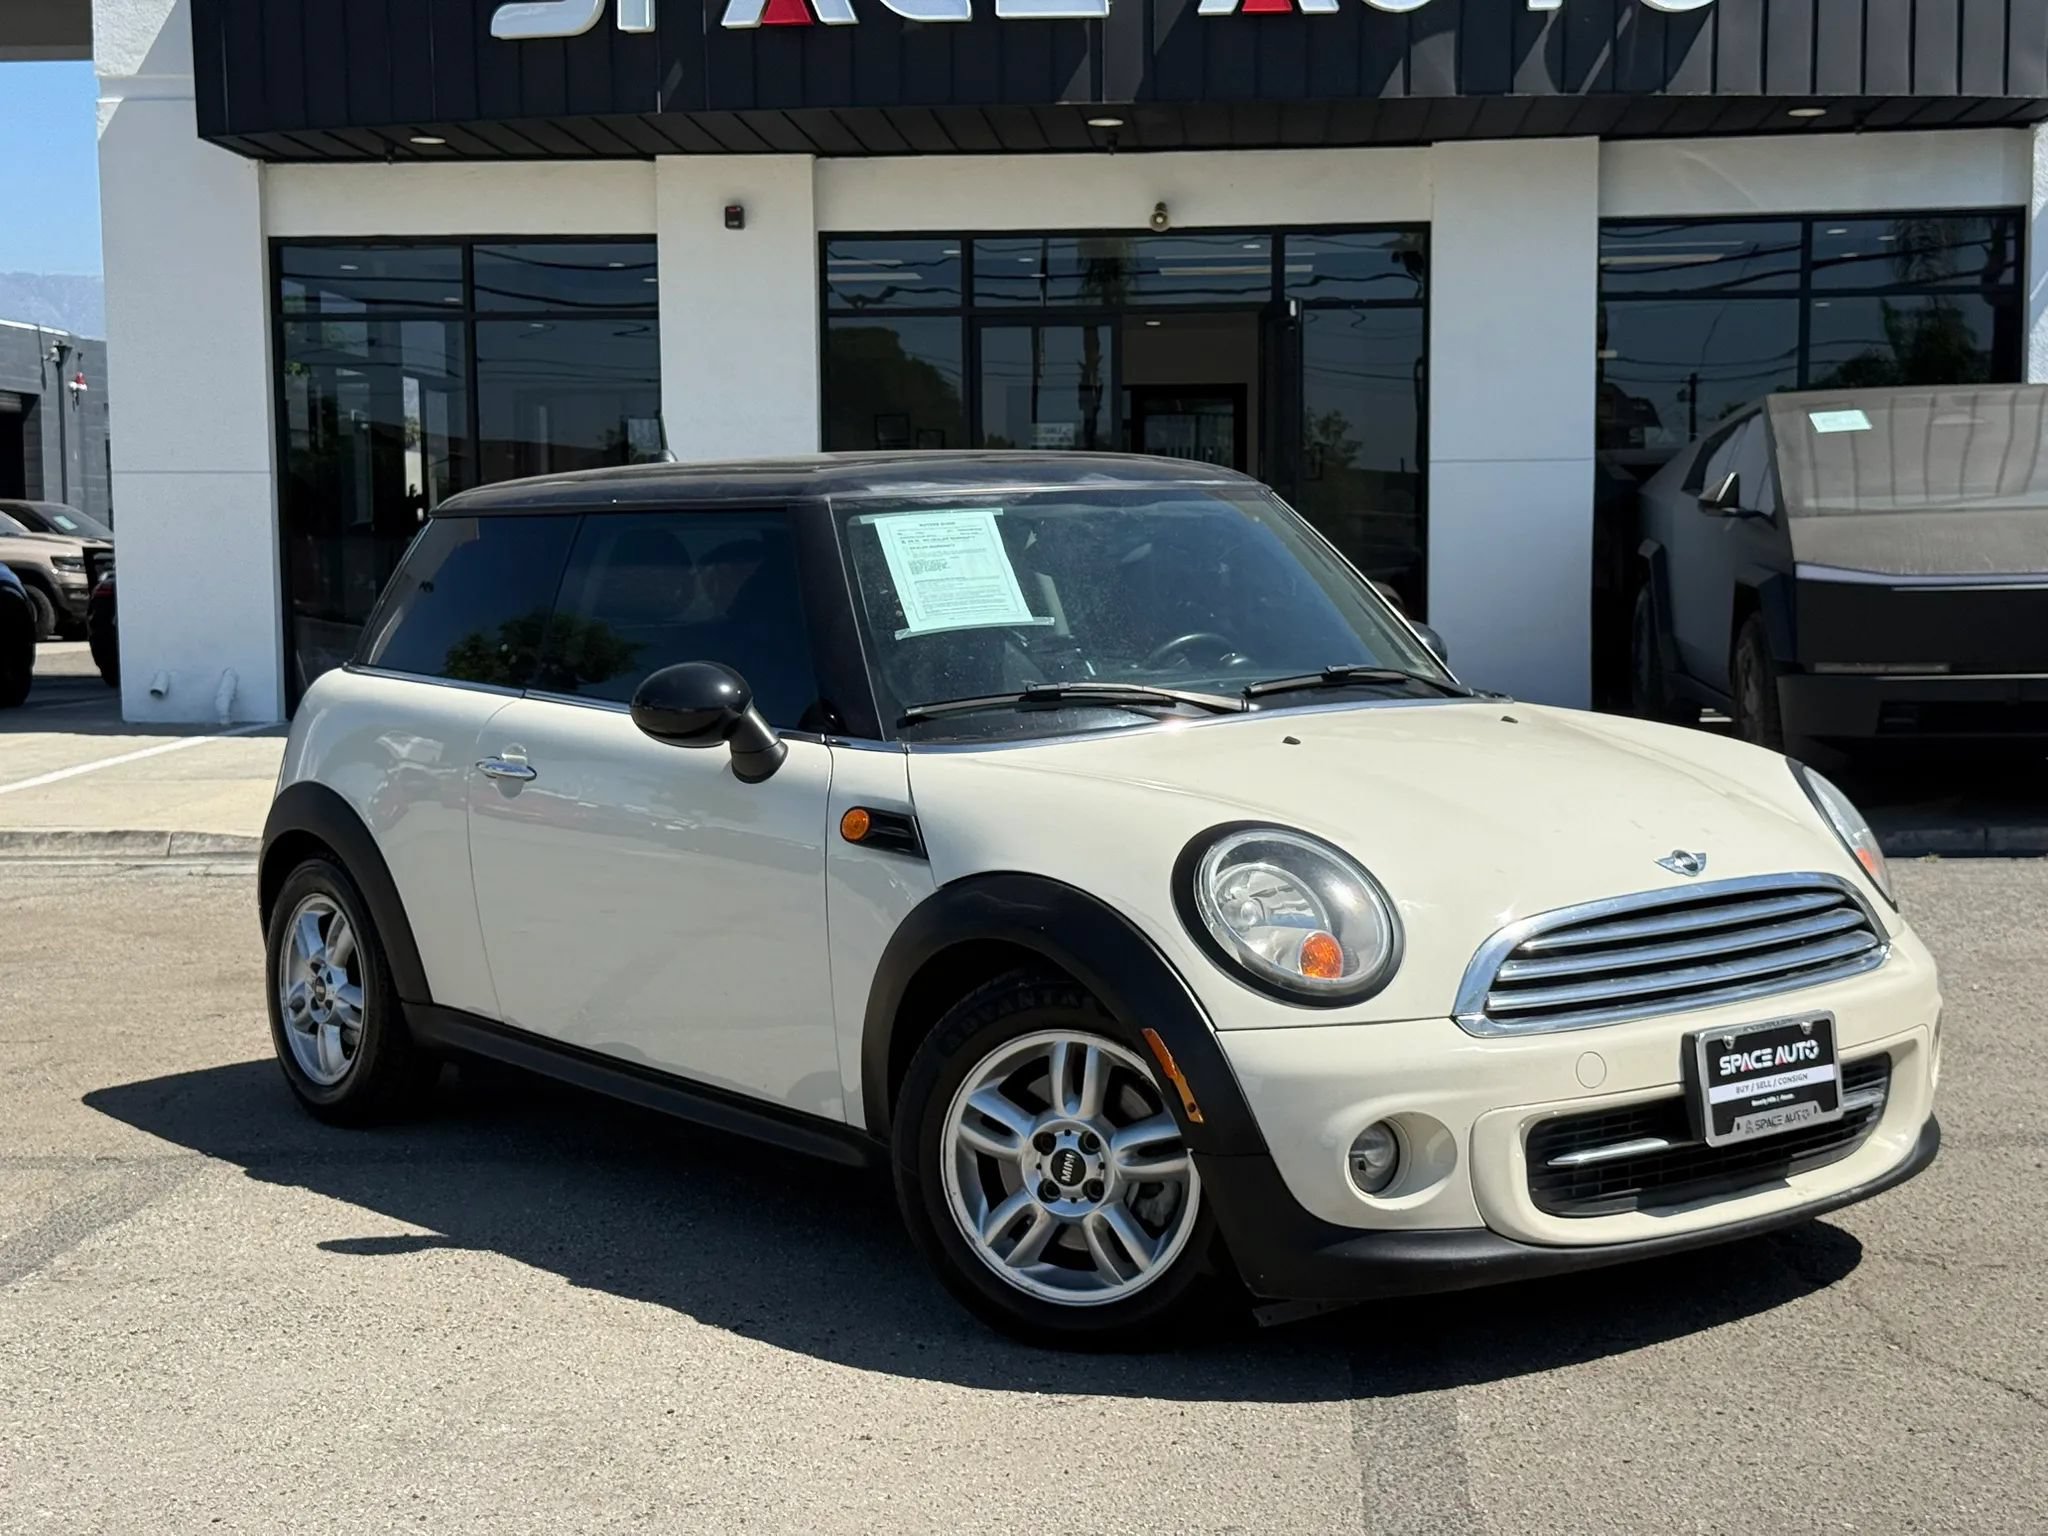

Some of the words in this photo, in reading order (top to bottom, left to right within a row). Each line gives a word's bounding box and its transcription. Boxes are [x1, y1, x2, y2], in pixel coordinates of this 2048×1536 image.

[1719, 1047, 1773, 1076] SPACE
[1775, 1039, 1820, 1066] AUTO
[1756, 1079, 1772, 1091] SELL
[1777, 1073, 1809, 1086] CONSIGN
[1061, 1153, 1076, 1182] MINI
